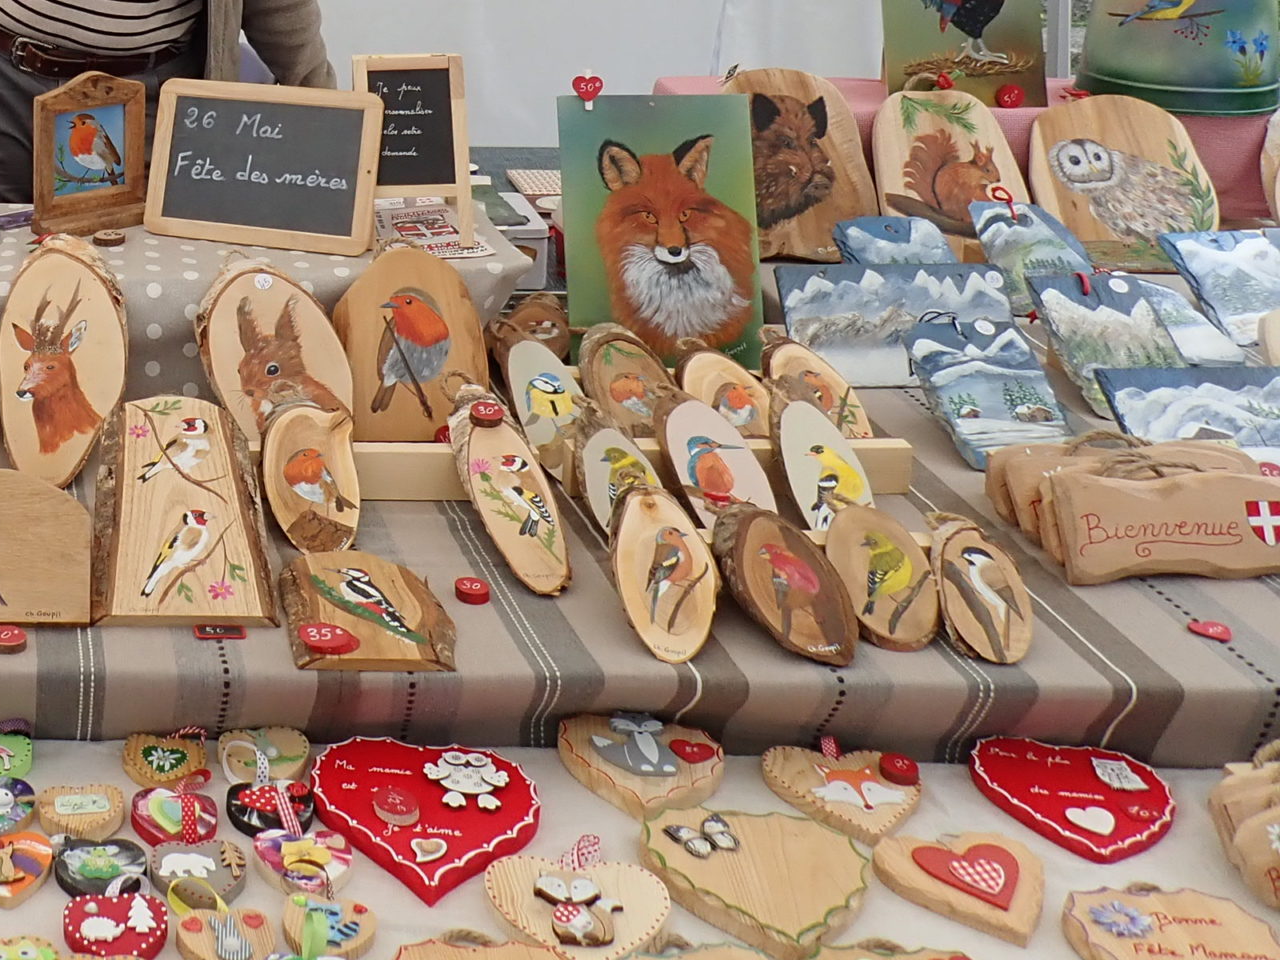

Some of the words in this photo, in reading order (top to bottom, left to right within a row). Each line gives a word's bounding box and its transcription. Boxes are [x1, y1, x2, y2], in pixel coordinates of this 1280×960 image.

[183, 106, 217, 129] 26
[235, 112, 284, 140] Mai
[174, 151, 225, 181] Fête
[235, 154, 269, 185] des
[275, 170, 349, 190] mères
[1080, 513, 1243, 557] Bienvenue
[36, 610, 61, 619] Goupil
[334, 759, 356, 771] Ma
[368, 765, 414, 776] mamie
[413, 824, 463, 837] t'aime
[1150, 912, 1222, 933] Bonne
[1190, 943, 1270, 960] Maman
